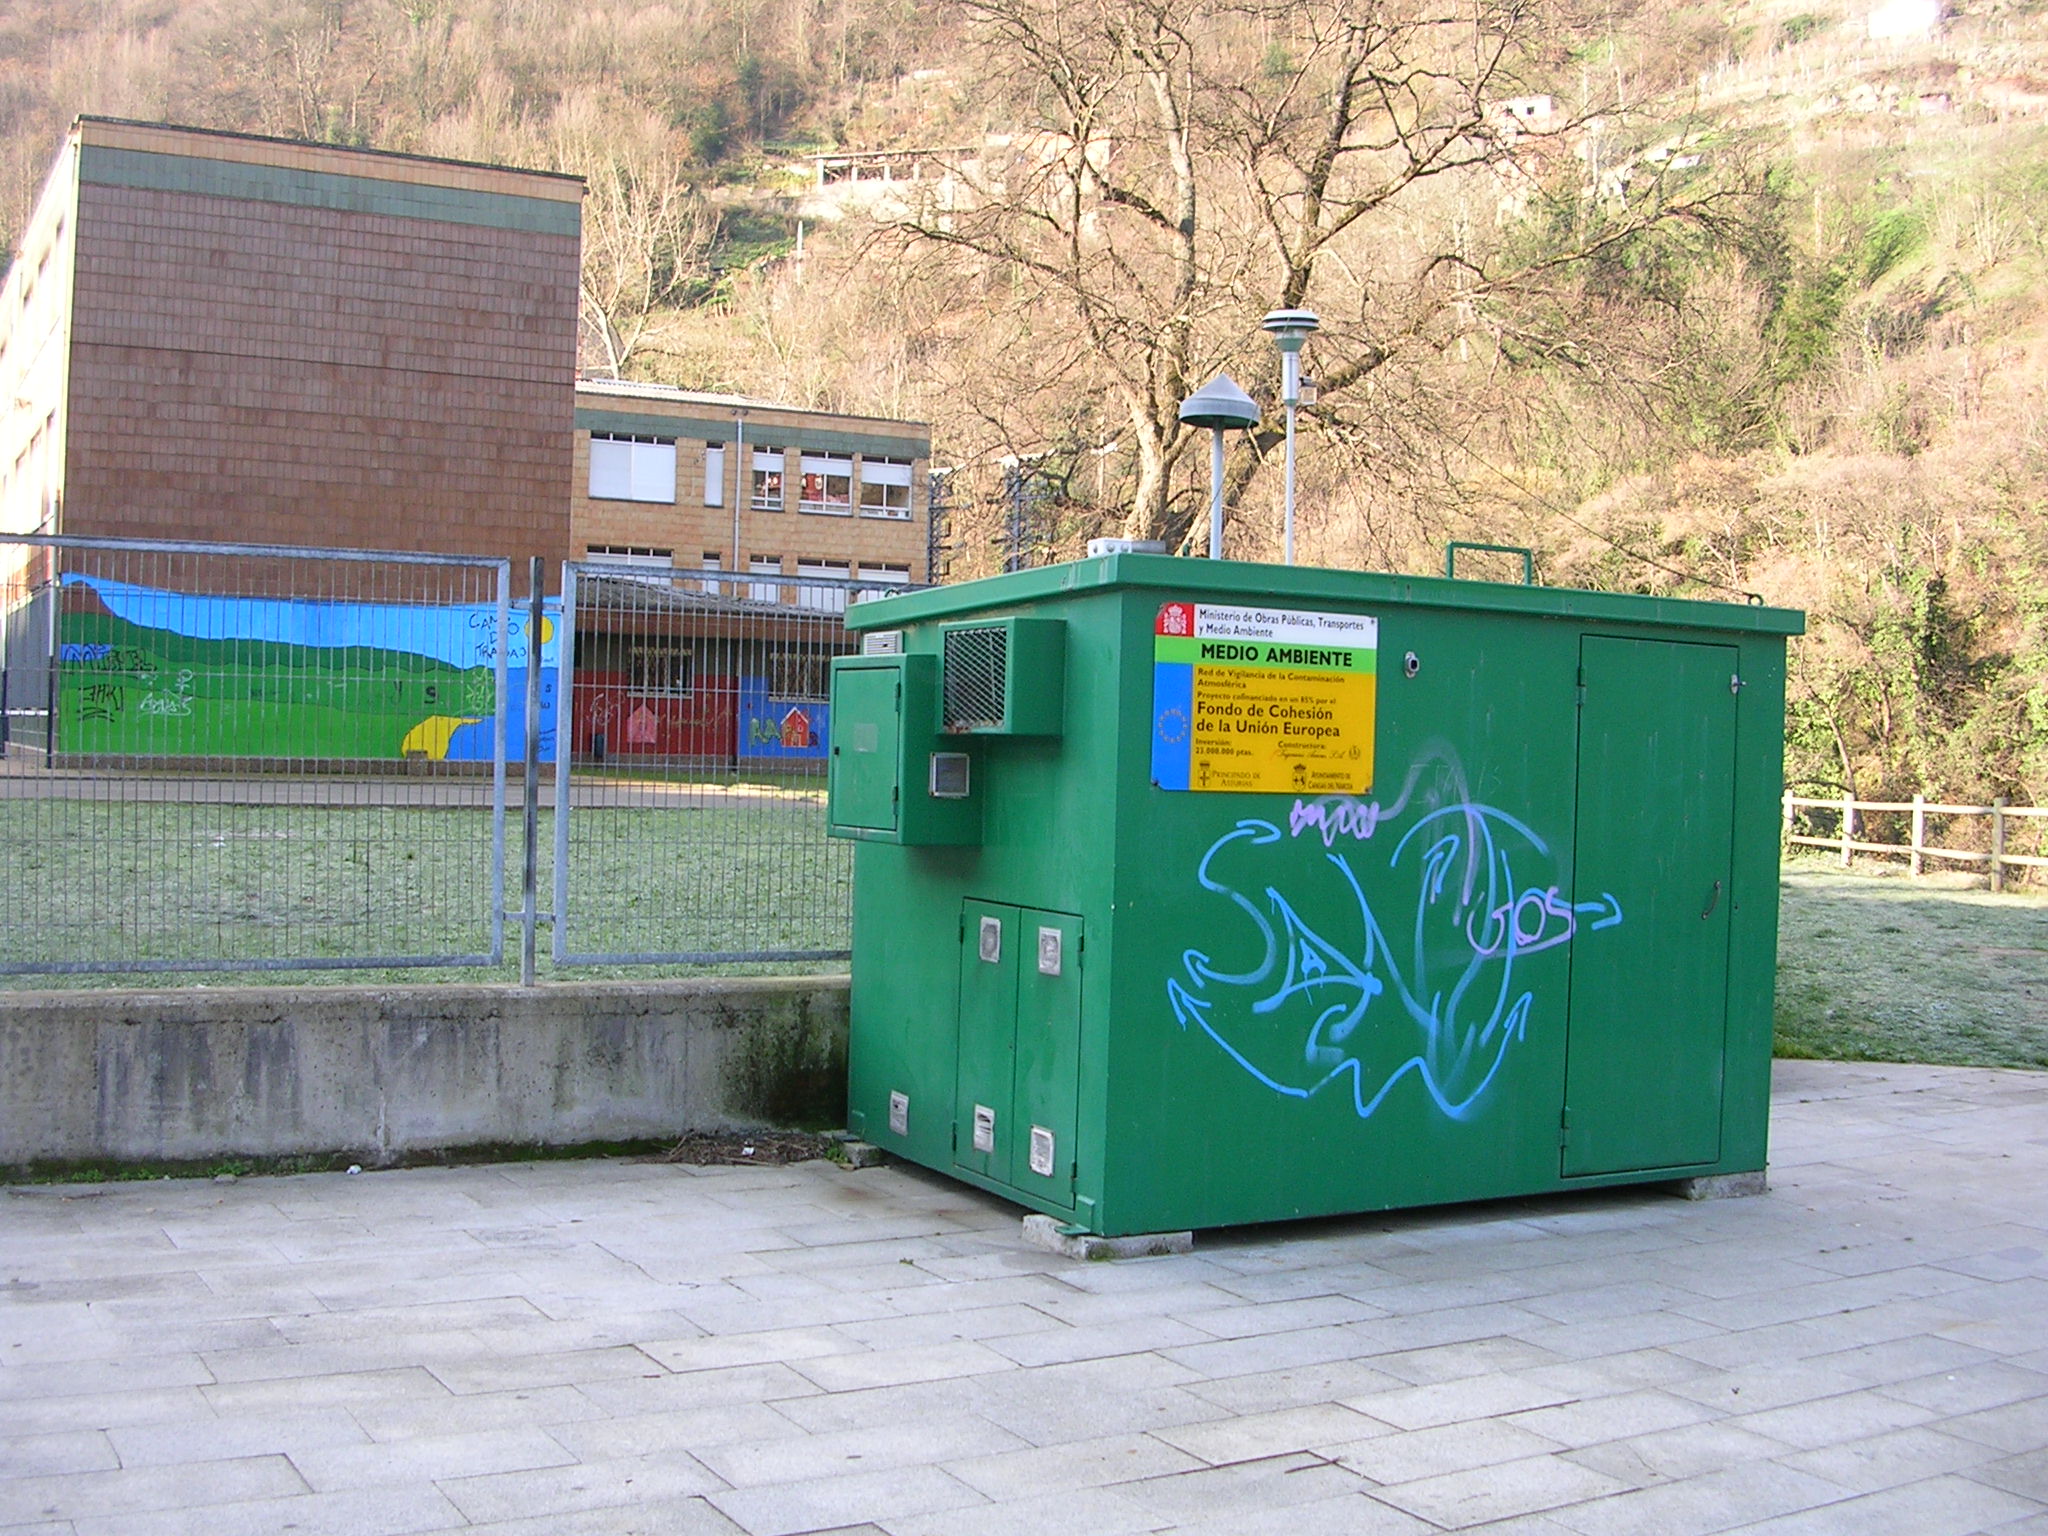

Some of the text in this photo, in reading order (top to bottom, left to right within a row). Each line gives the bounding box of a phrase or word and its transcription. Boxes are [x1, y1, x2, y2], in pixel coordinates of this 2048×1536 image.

[1199, 608, 1364, 631] Ministerio de Obras Públicas, Transportes
[1199, 623, 1274, 638] y Medio Ambiente
[1201, 643, 1353, 667] MEDIO AMBIENTE
[1198, 667, 1214, 676] Red
[1216, 669, 1225, 677] de
[1227, 669, 1266, 679] Vigilancia
[1278, 672, 1286, 680] la
[1287, 673, 1345, 683] Contaminación
[1197, 691, 1231, 701] Proyecto
[1233, 692, 1278, 702] cofinanciado
[1197, 701, 1334, 721] Fondo de Cohesión
[1196, 718, 1340, 739] de la Unión Europea
